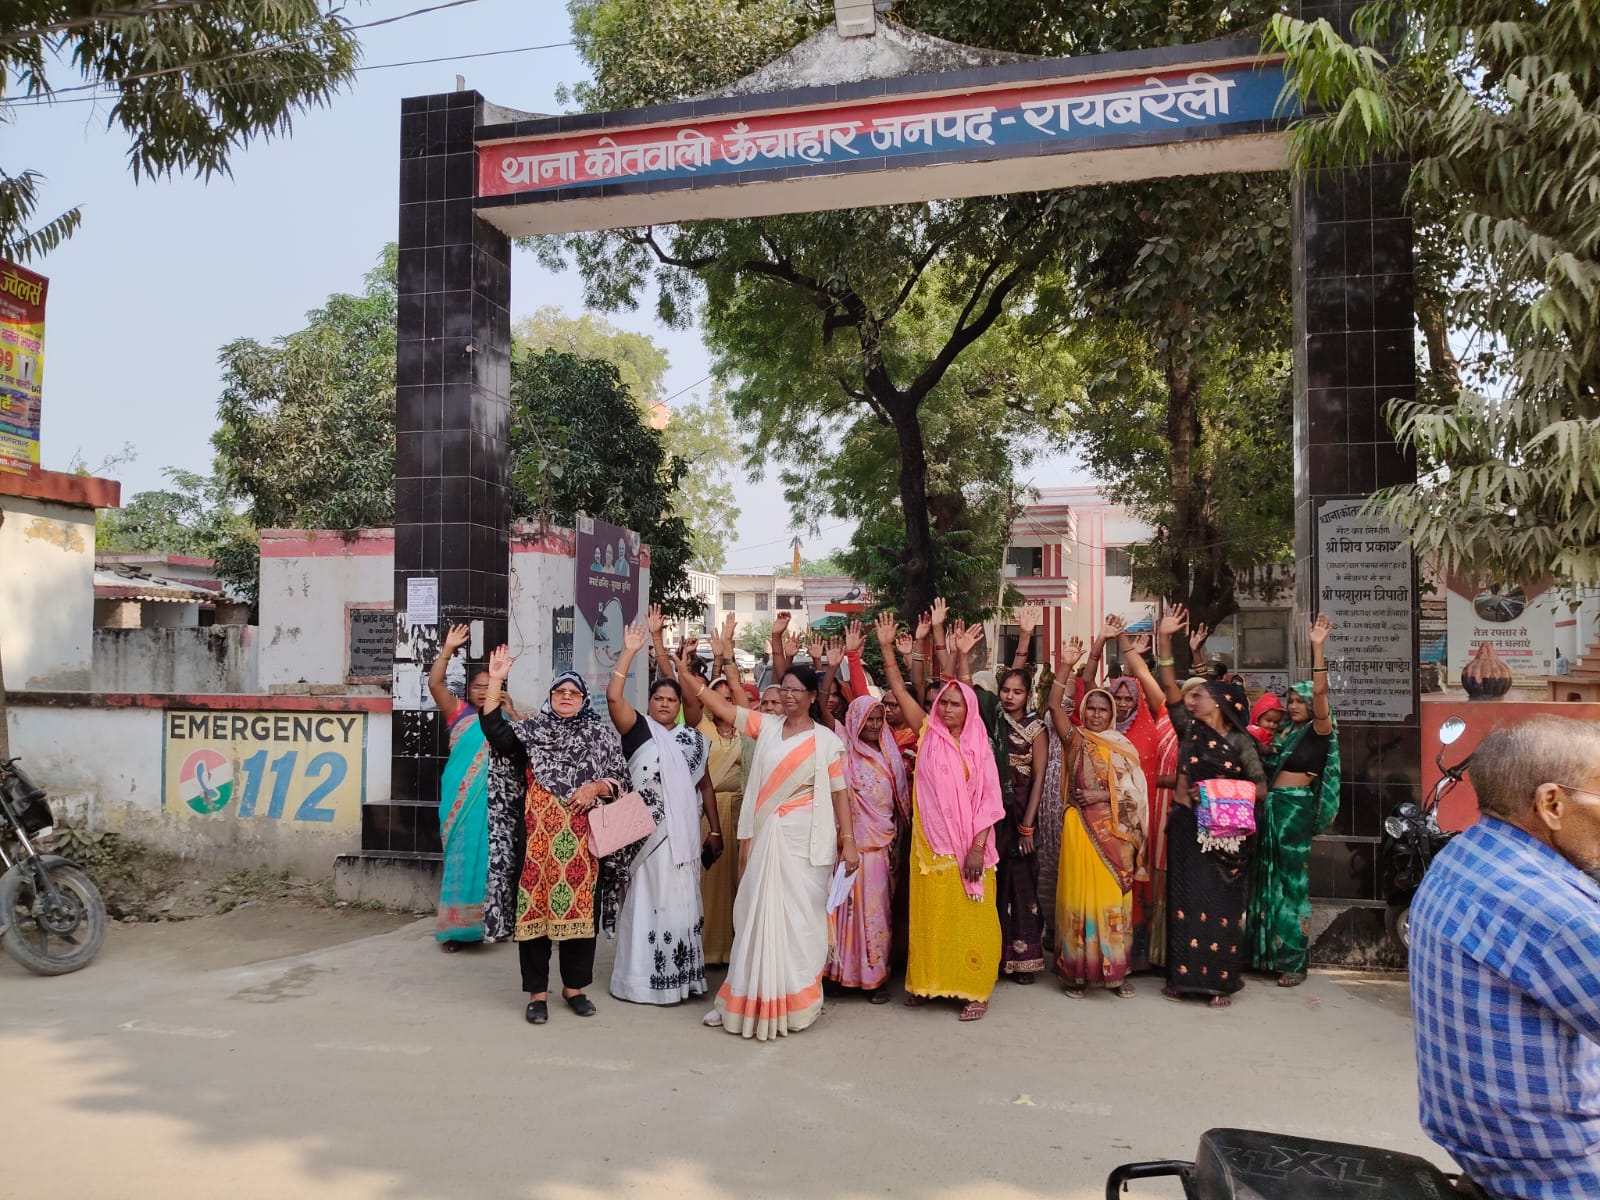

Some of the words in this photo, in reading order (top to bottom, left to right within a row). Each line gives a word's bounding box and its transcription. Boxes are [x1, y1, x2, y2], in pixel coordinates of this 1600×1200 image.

[501, 151, 578, 185] थाना
[584, 128, 715, 177] कोतवाली
[721, 121, 864, 165] ऊँचाहार
[871, 106, 998, 151] जनपद
[1021, 72, 1237, 135] रायबरेली
[1326, 537, 1338, 553] श्री
[1340, 537, 1363, 553] शिव
[1322, 585, 1333, 601] श्री
[1334, 590, 1371, 605] परशुराम
[1373, 585, 1409, 601] त्रिपाठी
[1473, 627, 1488, 637] तेज
[1490, 627, 1517, 637] रफ्तार
[1519, 627, 1528, 637] से
[1496, 640, 1503, 648] न
[1361, 660, 1384, 675] कुमार
[1385, 657, 1411, 673] पाण्डेय
[170, 714, 357, 743] EMERGENCY
[237, 749, 348, 822] 112
